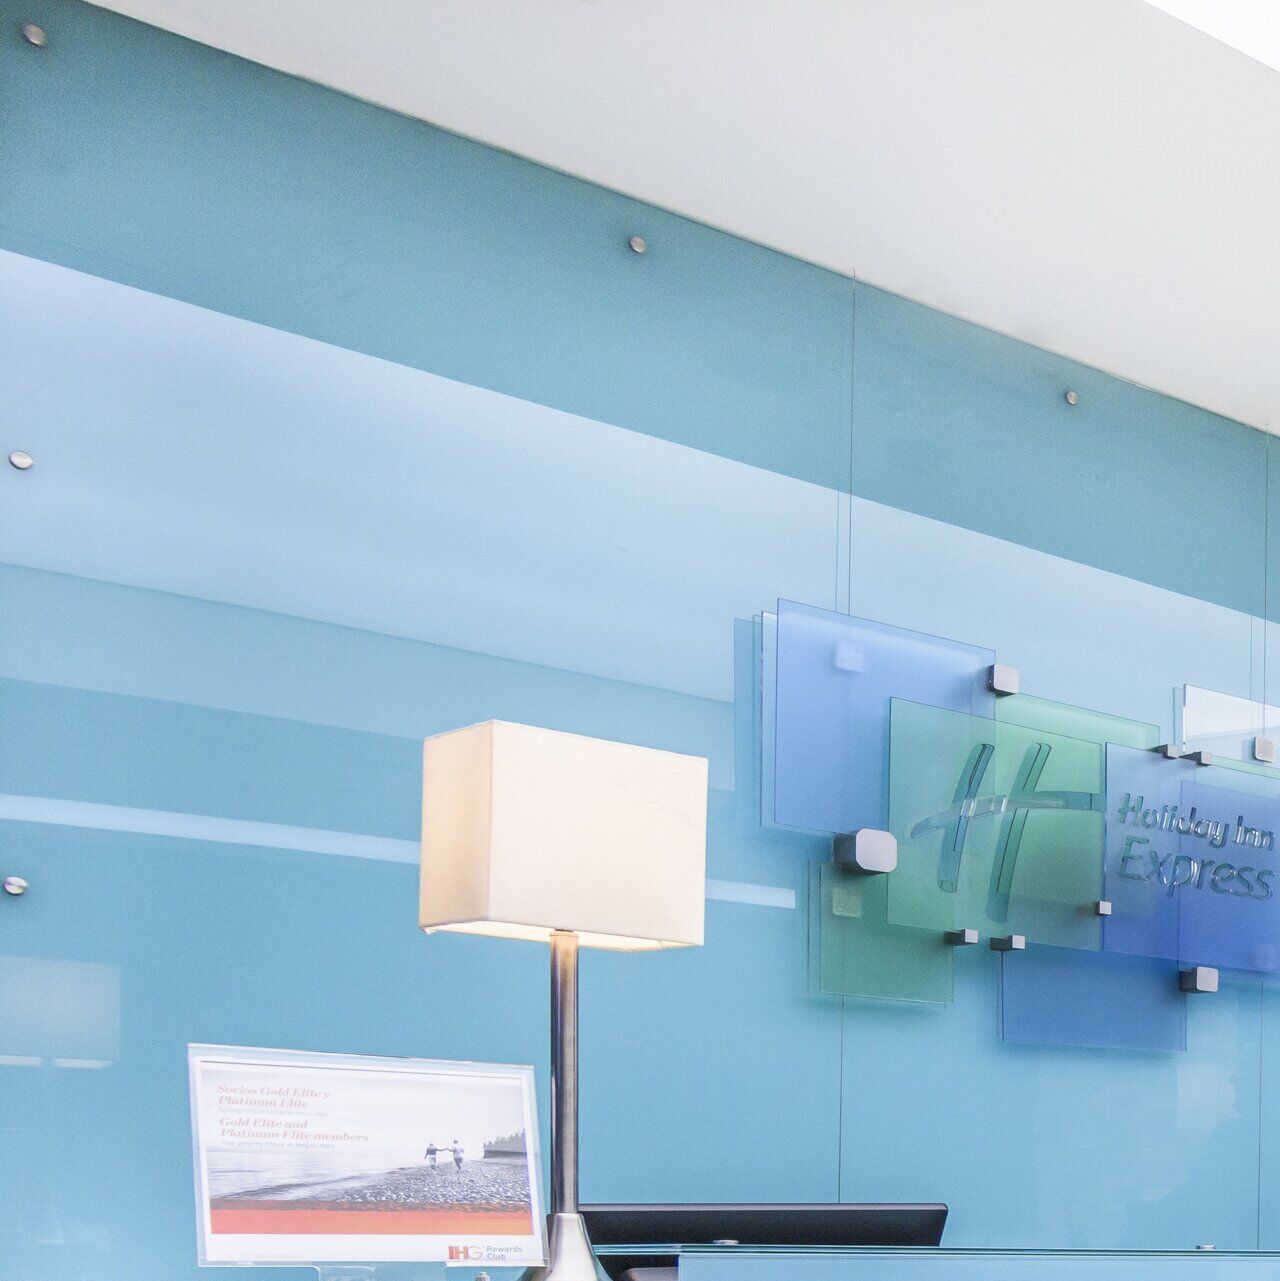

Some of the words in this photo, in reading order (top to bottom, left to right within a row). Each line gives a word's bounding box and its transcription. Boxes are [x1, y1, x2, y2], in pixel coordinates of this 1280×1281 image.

[1117, 792, 1230, 849] Holiday
[1233, 815, 1275, 851] Inn
[1118, 835, 1276, 902] Express
[216, 1083, 257, 1095] Socios
[260, 1086, 289, 1096] Gold
[293, 1087, 321, 1098] Elite
[322, 1090, 331, 1100] y
[218, 1094, 277, 1107] Platinum
[280, 1097, 311, 1109] Elite
[219, 1117, 250, 1127] Gold
[252, 1118, 282, 1129] Elite
[282, 1119, 308, 1130] and
[220, 1128, 279, 1139] Platinum
[282, 1130, 311, 1141] Elite
[313, 1131, 369, 1143] members
[486, 1245, 523, 1253] Rewards
[486, 1252, 506, 1260] Club
